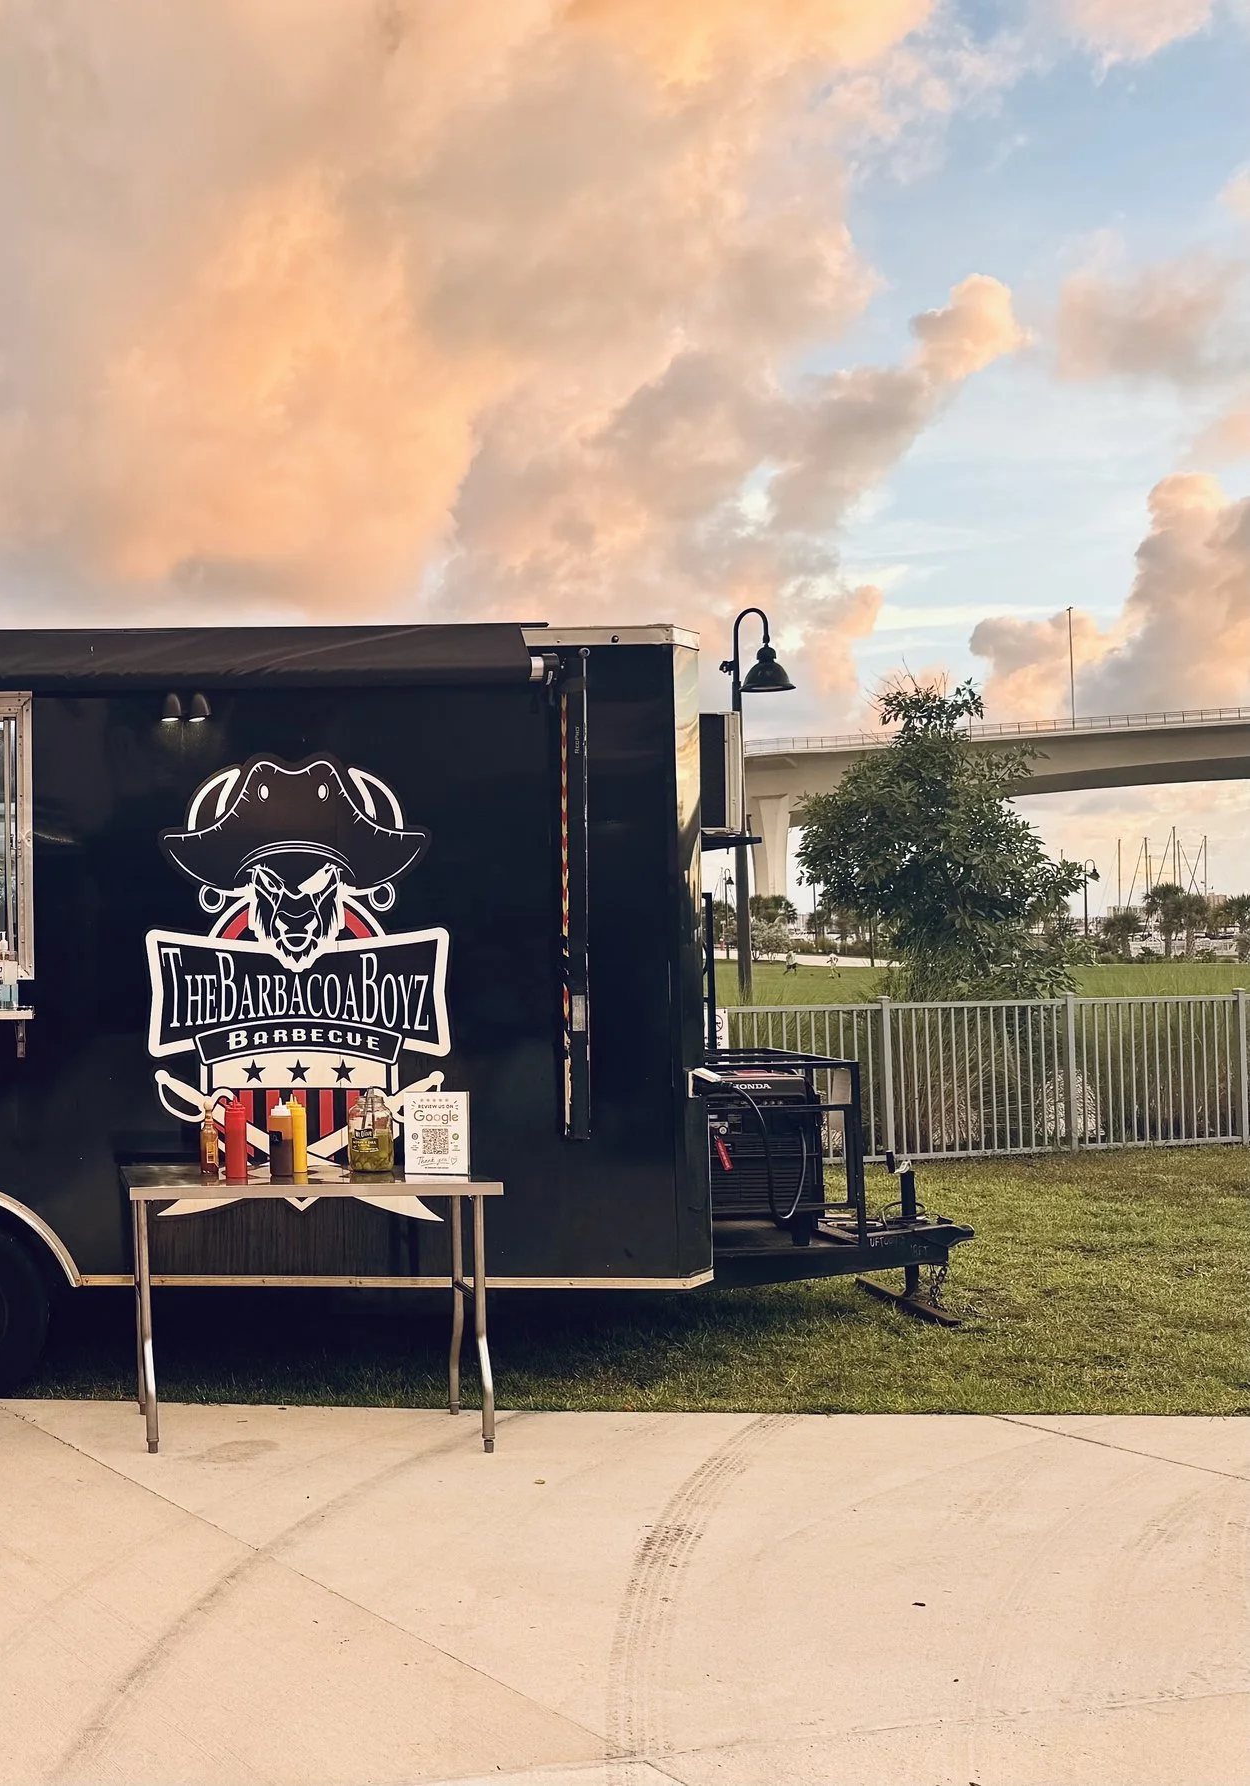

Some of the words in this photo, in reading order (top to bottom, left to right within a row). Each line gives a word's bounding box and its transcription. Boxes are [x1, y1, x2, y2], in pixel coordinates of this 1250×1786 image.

[226, 1028, 381, 1051] BARBECUE
[413, 1109, 459, 1125] Google
[416, 1156, 435, 1165] Thank
